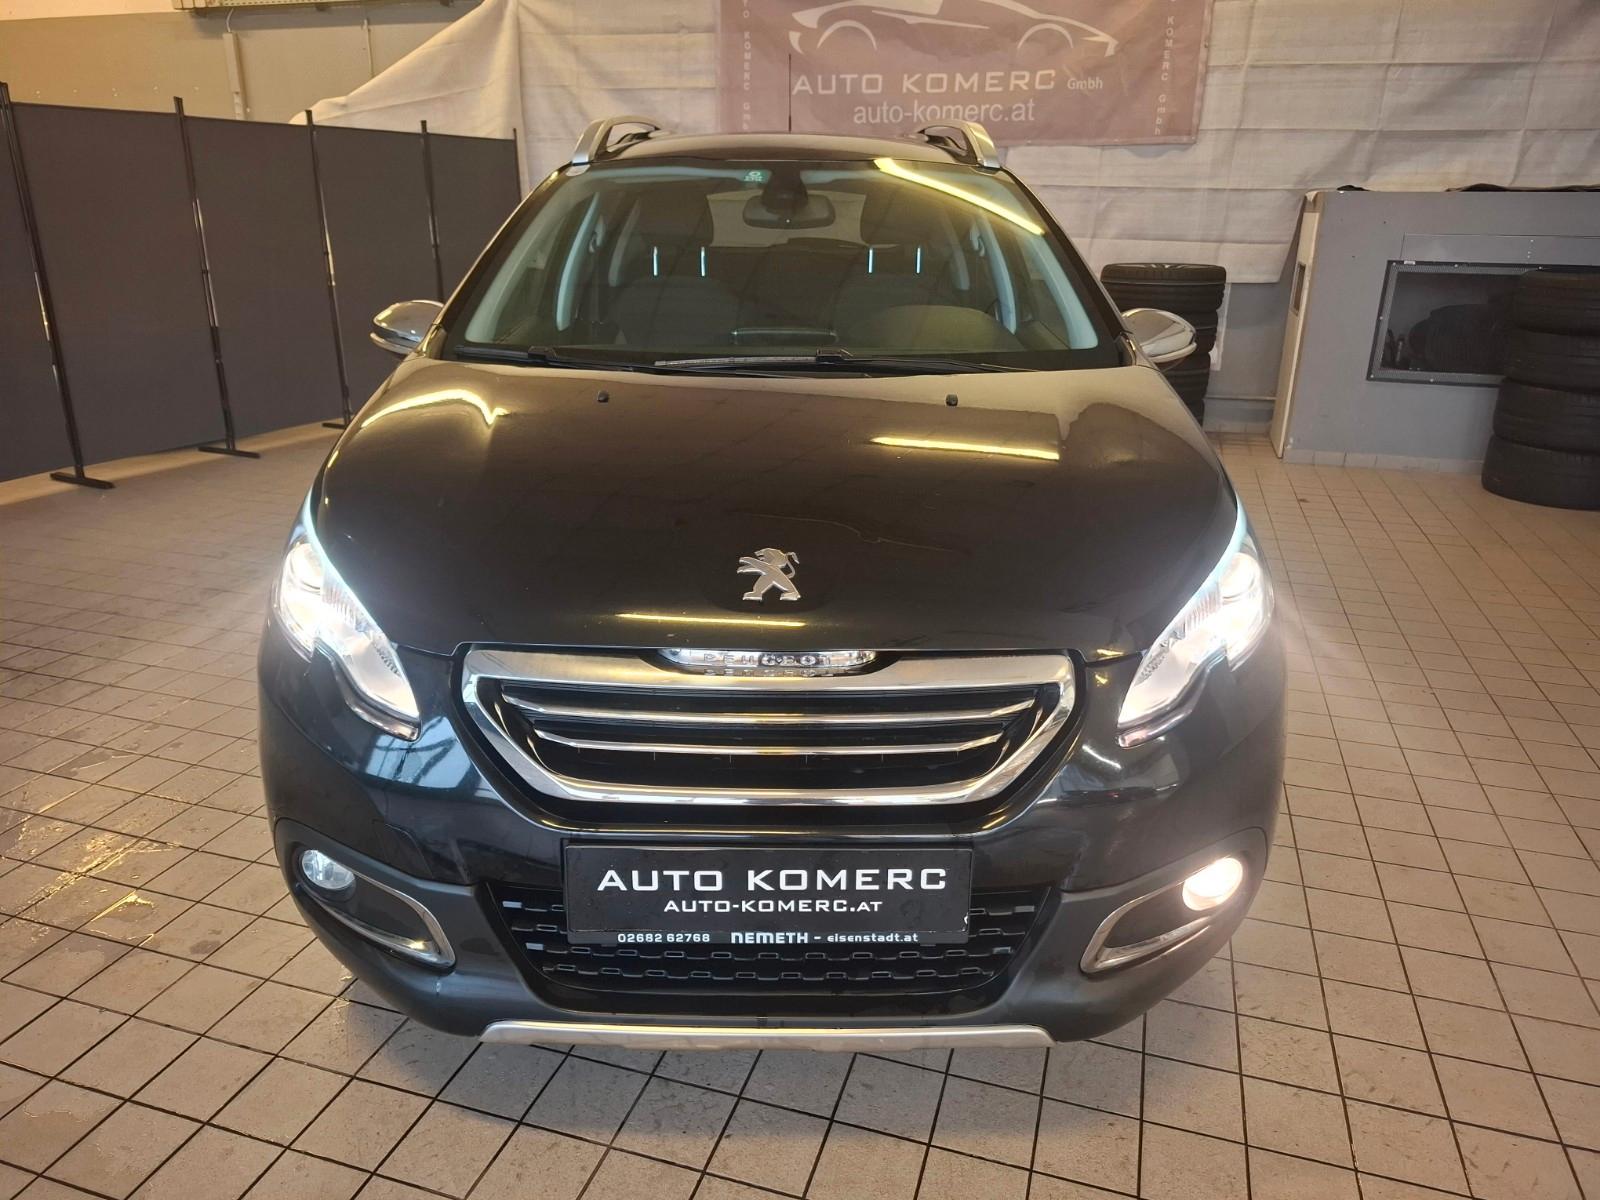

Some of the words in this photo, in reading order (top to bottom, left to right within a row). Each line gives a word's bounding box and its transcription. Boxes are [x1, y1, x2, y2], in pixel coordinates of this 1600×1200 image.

[1161, 15, 1175, 81] KOMERC
[743, 31, 751, 91] KOMERC
[792, 74, 883, 95] AUTO
[902, 69, 1056, 93] KOMERC
[1067, 77, 1104, 91] Gmbh
[853, 99, 1035, 124] auto-komerc.at
[1154, 94, 1166, 136] Gmbh
[597, 869, 723, 892] AUTO
[747, 868, 947, 891] KOMERC
[664, 899, 883, 913] AUTO-KOMERC.AT
[617, 933, 664, 944] 02682
[667, 933, 711, 944] 62768
[826, 932, 919, 943] eisenstadt.at
